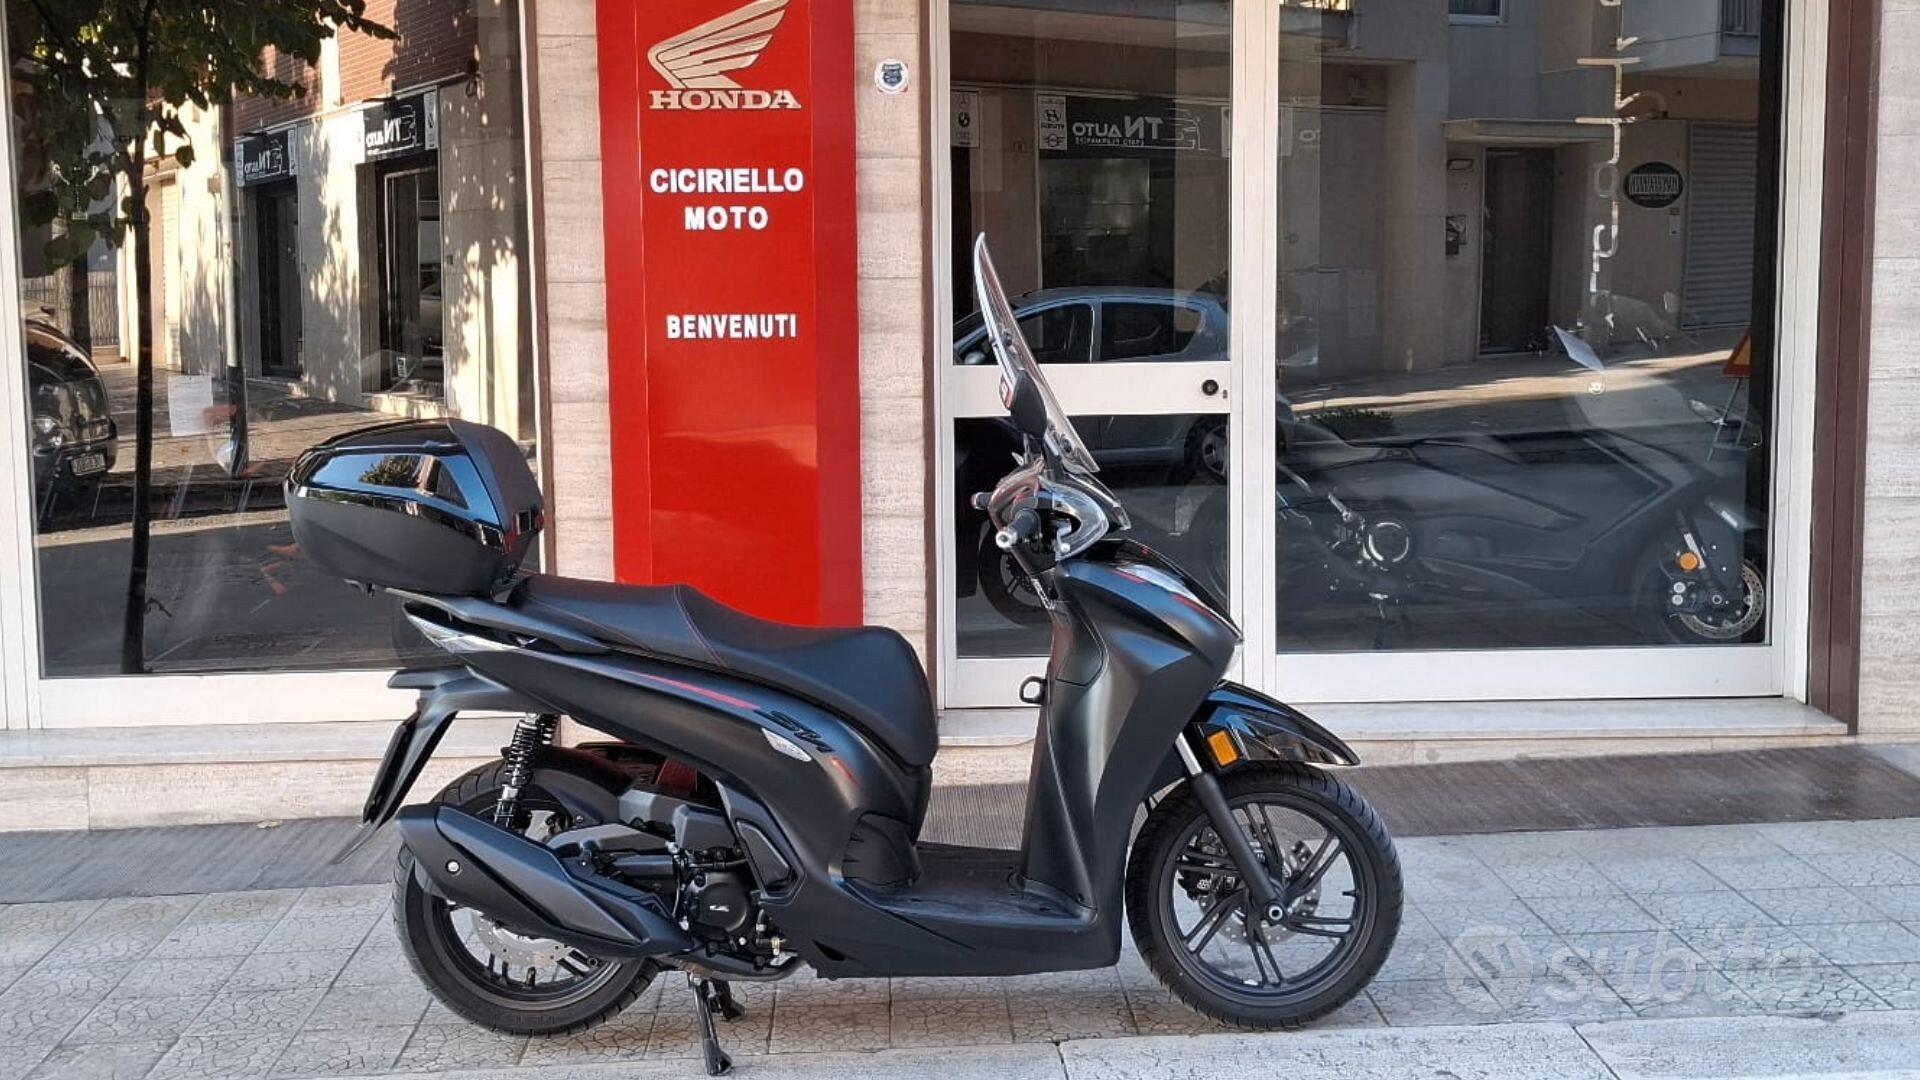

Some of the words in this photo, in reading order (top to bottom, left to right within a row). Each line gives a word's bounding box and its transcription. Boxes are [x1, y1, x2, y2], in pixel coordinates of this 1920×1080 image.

[648, 90, 802, 110] HONDA
[649, 168, 805, 193] CICIRIELLO
[684, 205, 769, 231] MOTO
[666, 314, 798, 339] BENVENUTI
